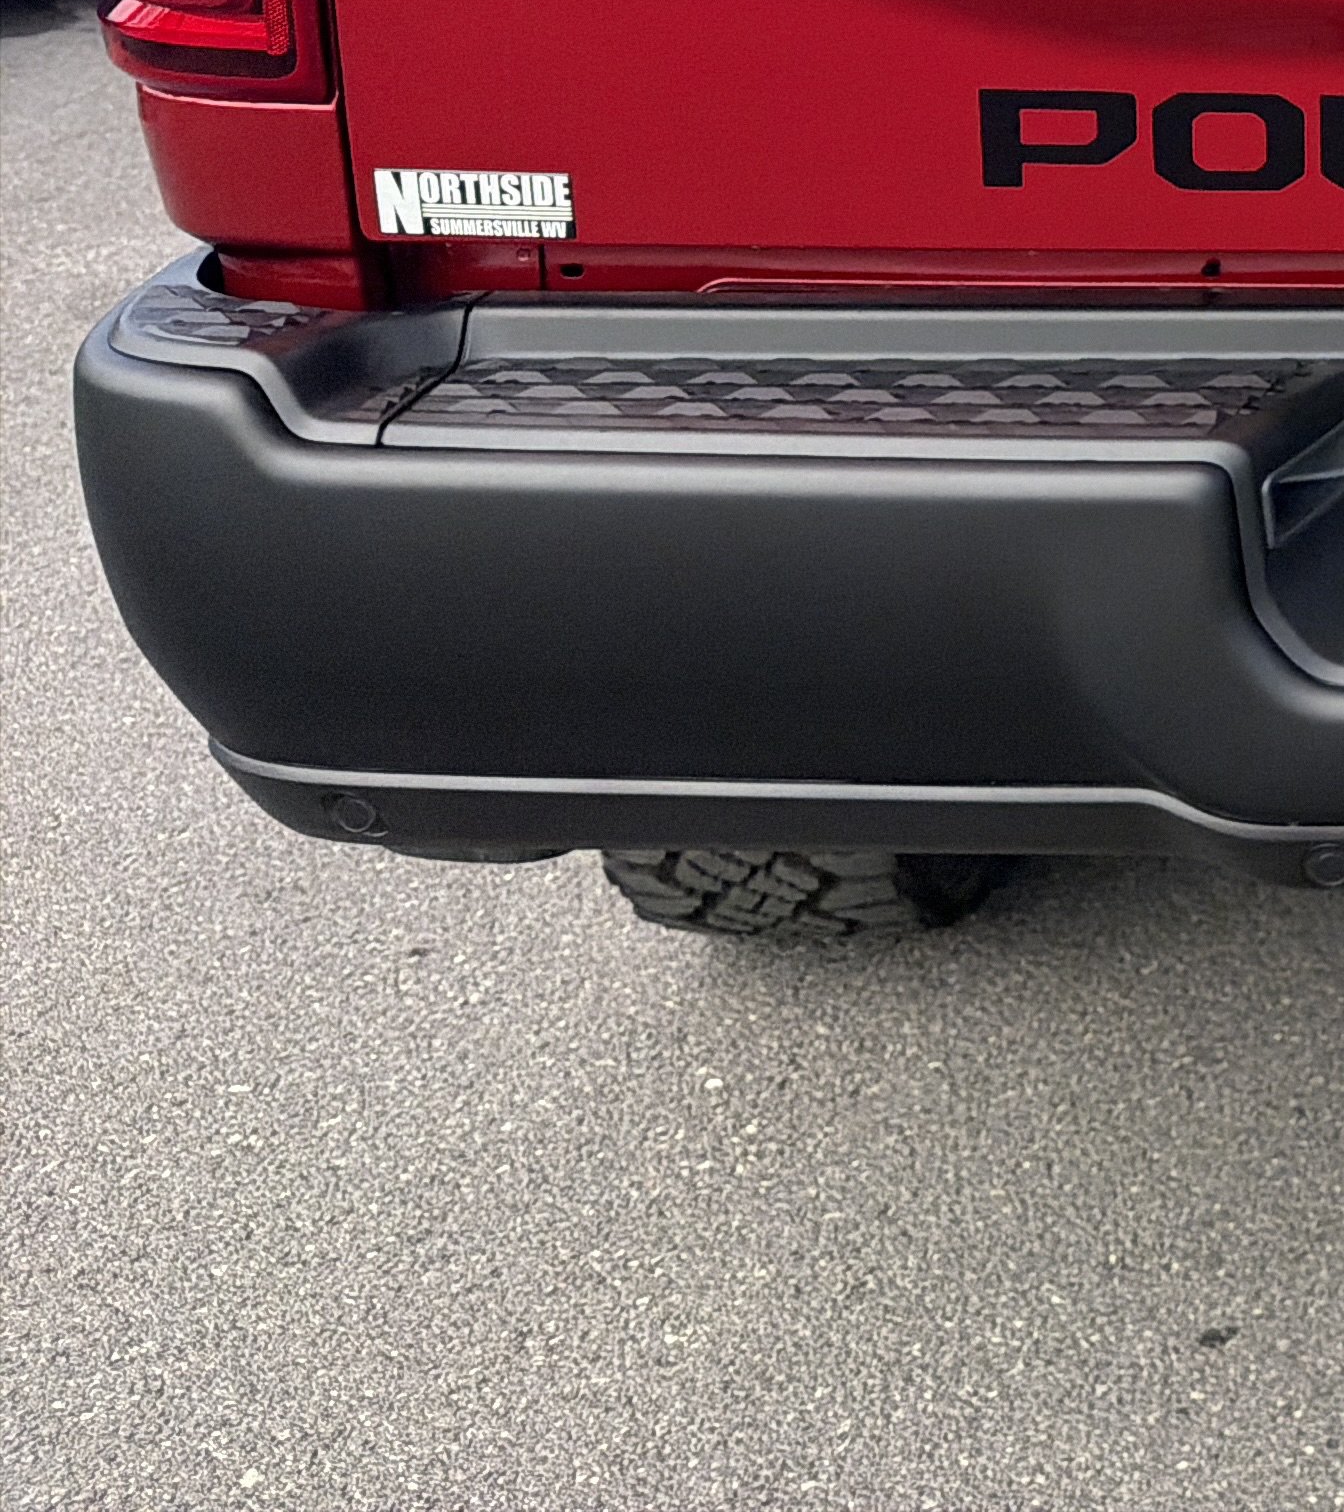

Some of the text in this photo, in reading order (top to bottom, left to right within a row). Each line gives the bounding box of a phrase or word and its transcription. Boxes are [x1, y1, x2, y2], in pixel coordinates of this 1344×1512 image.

[373, 170, 572, 235] NORTHSIDE
[430, 218, 567, 239] SUMMERSVILLE WV
